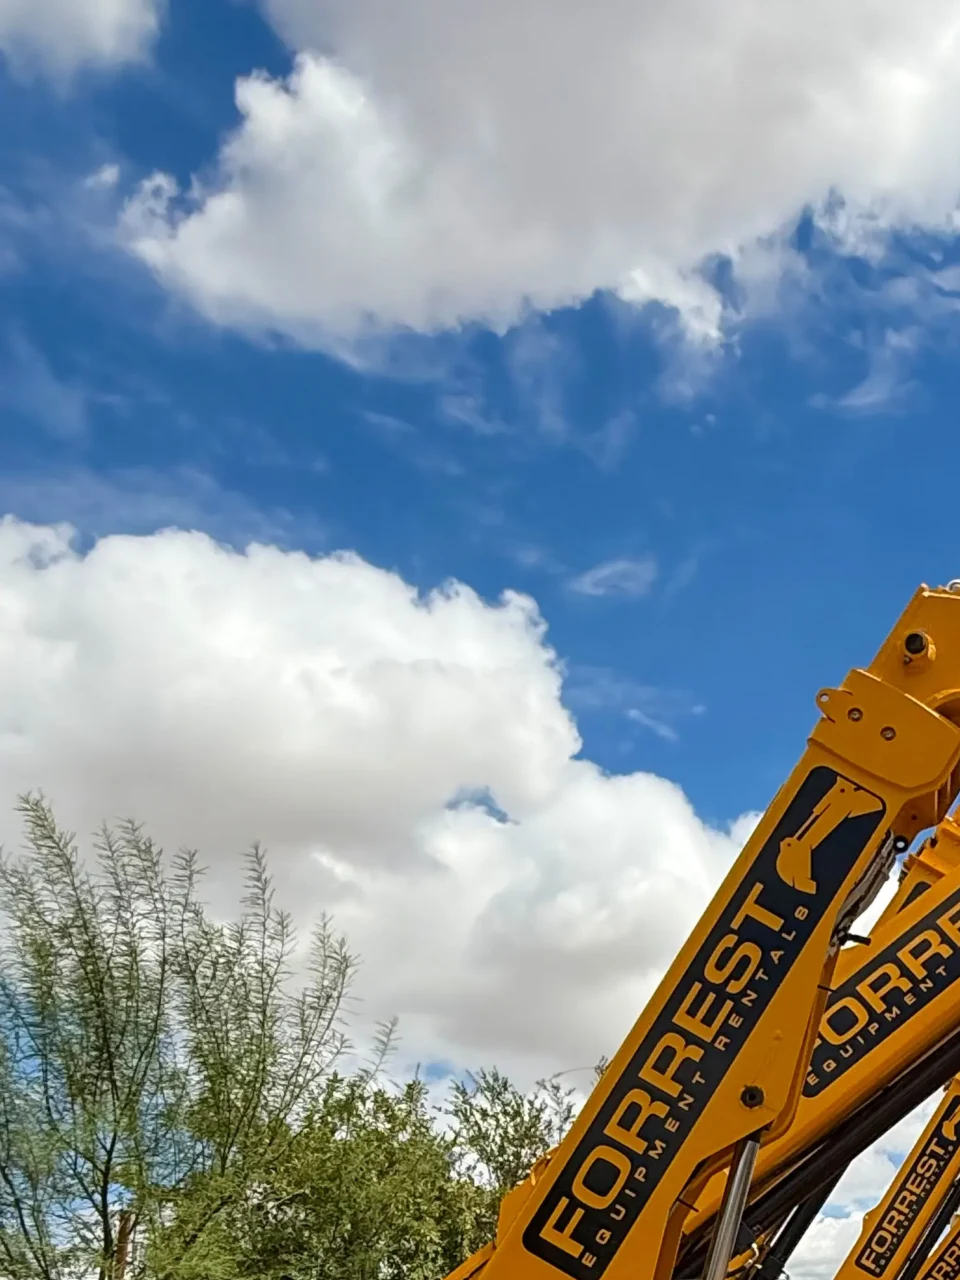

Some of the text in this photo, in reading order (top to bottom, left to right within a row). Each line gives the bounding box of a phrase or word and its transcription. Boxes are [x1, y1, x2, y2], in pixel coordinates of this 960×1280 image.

[539, 882, 785, 1259] FORREST
[581, 906, 809, 1268] EQUIPMENT RENTALS
[806, 965, 948, 1086] EQUIPMENT
[860, 1137, 946, 1271] FORREST
[874, 1145, 954, 1273] EQUIPMENT RENTALS
